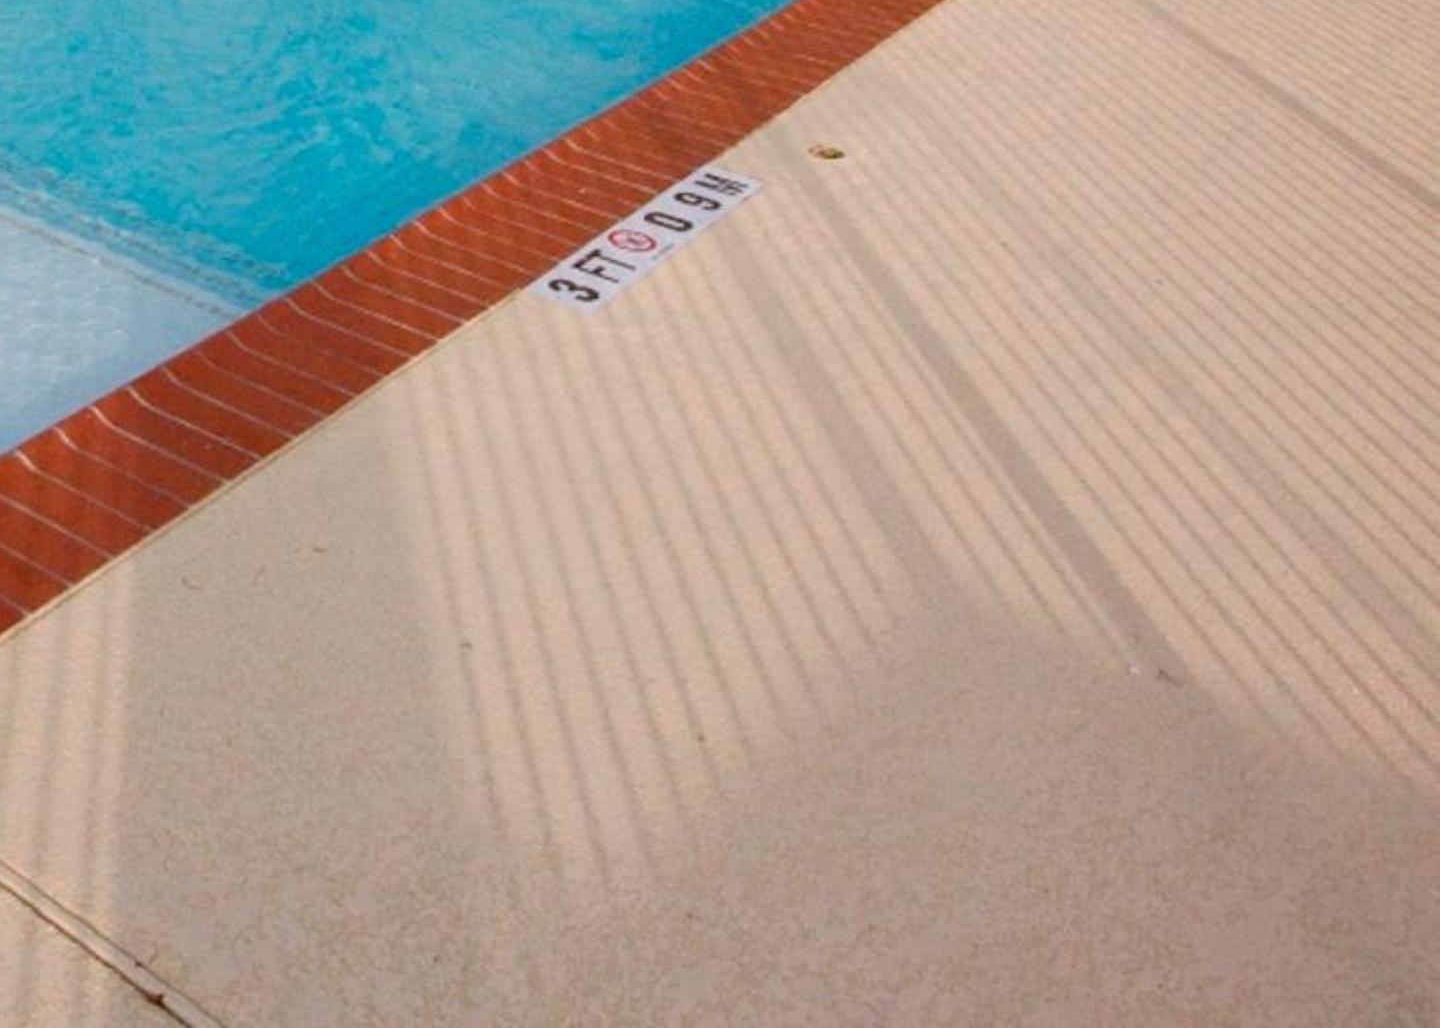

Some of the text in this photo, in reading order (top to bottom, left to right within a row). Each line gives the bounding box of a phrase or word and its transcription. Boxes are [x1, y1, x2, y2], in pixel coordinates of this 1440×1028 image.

[694, 173, 749, 196] M
[573, 249, 637, 284] FT
[549, 278, 600, 302] 3
